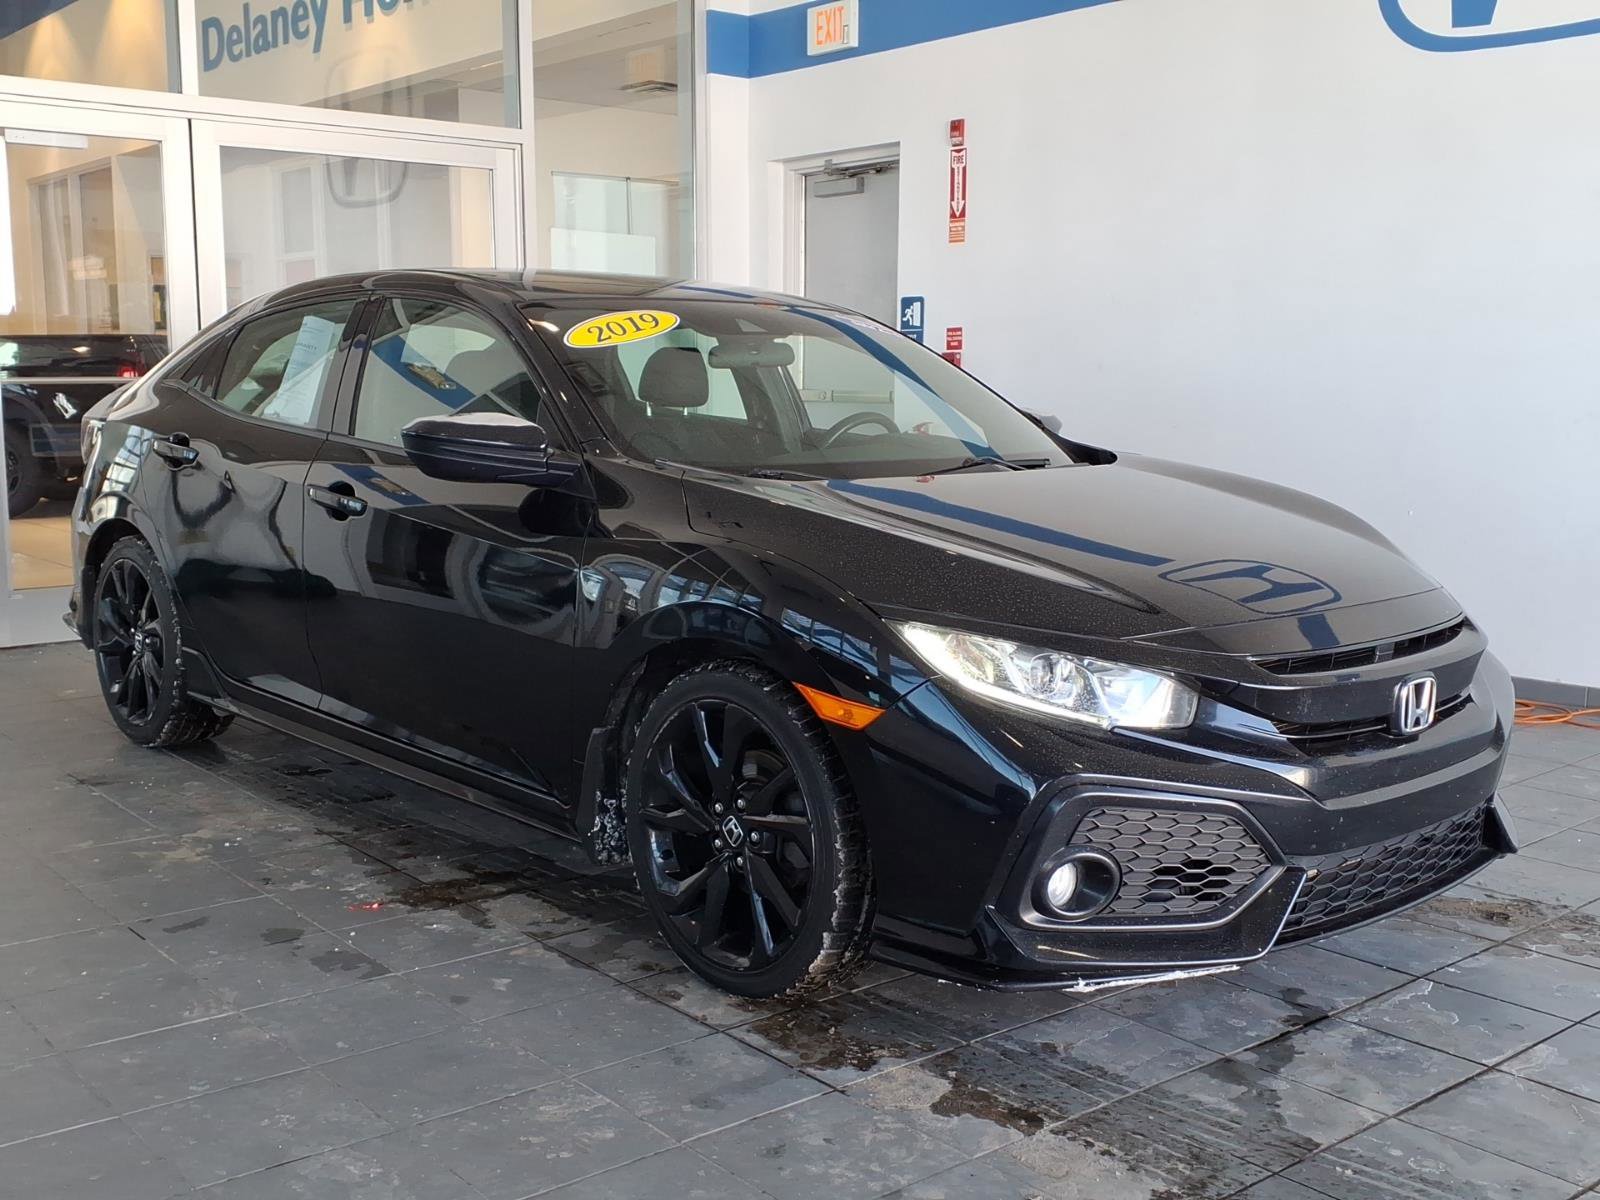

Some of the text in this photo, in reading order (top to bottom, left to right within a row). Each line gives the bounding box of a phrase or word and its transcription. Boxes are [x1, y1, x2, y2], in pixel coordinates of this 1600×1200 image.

[201, 0, 328, 72] Delaney
[816, 6, 845, 46] EXIT
[952, 154, 964, 165] FIRE
[588, 313, 660, 342] 2019
